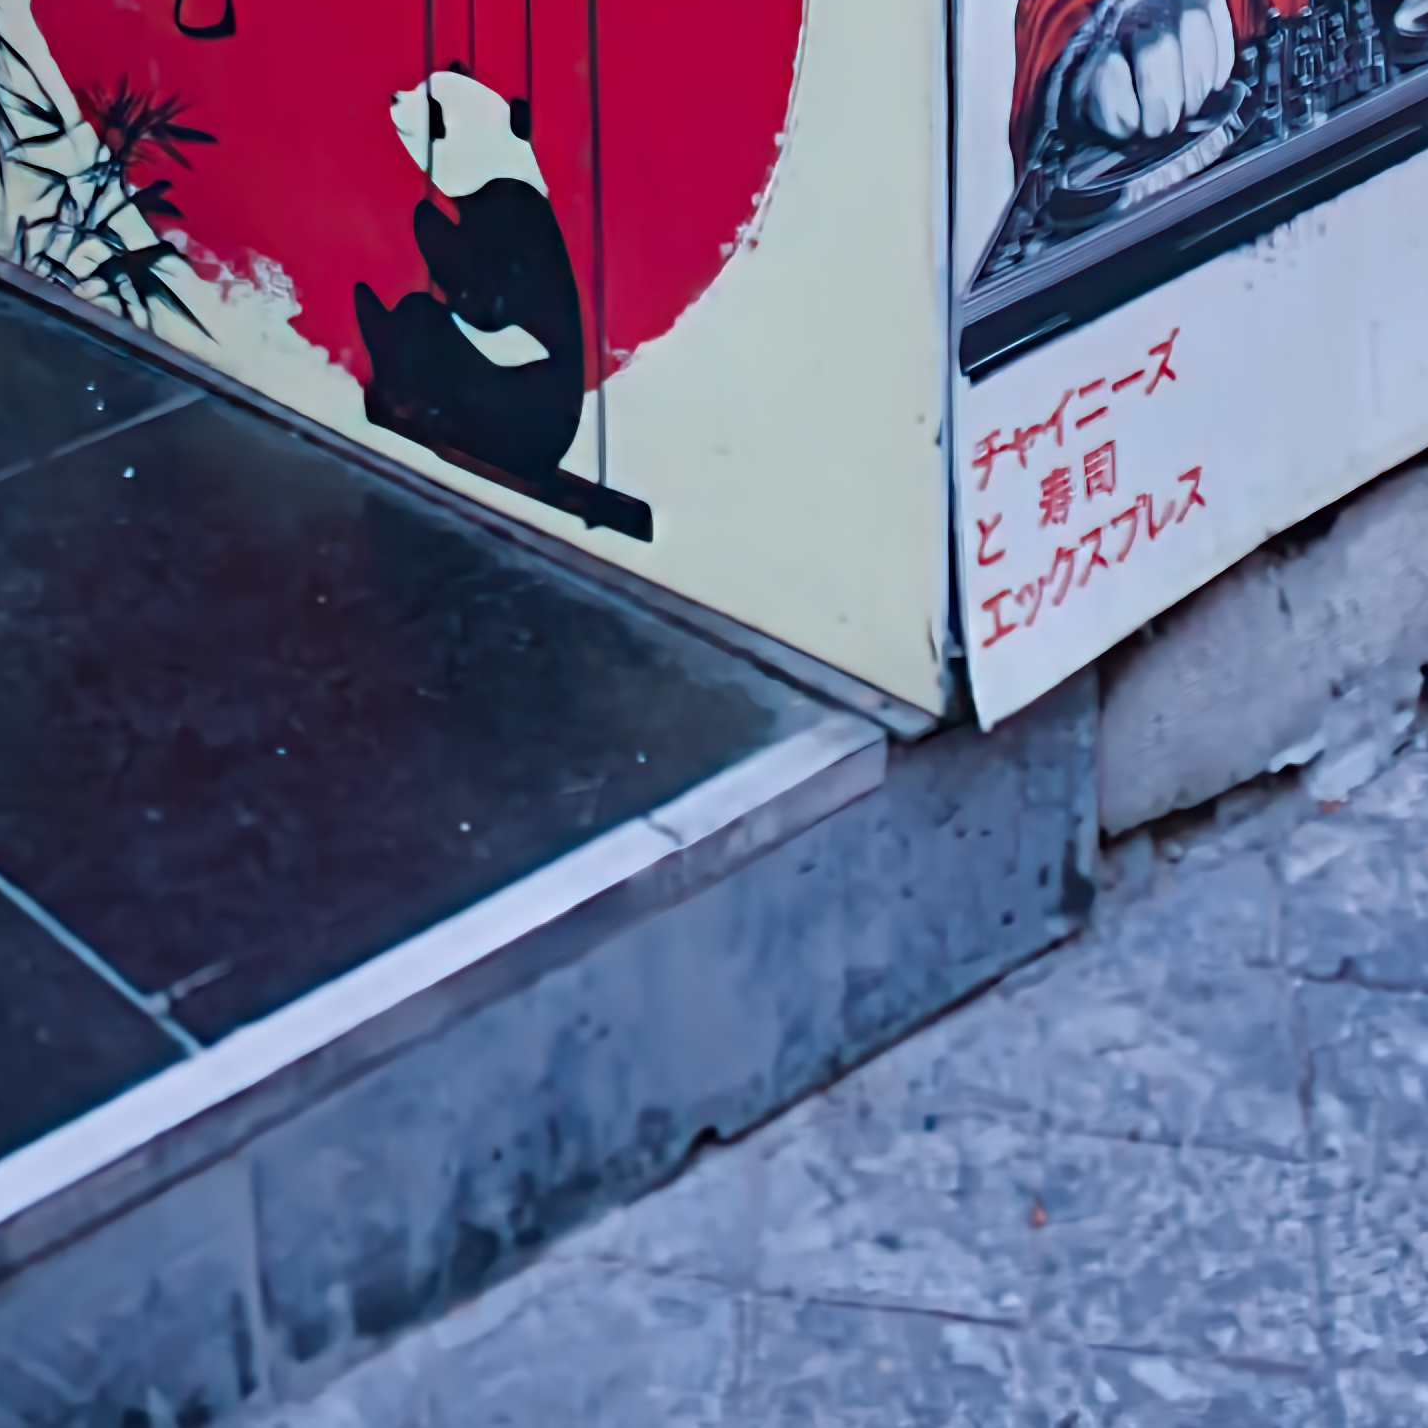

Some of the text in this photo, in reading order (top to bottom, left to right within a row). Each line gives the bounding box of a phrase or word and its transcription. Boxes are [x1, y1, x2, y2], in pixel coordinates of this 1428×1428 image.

[977, 512, 1006, 567] と
[981, 466, 1206, 648] エックスプレス
